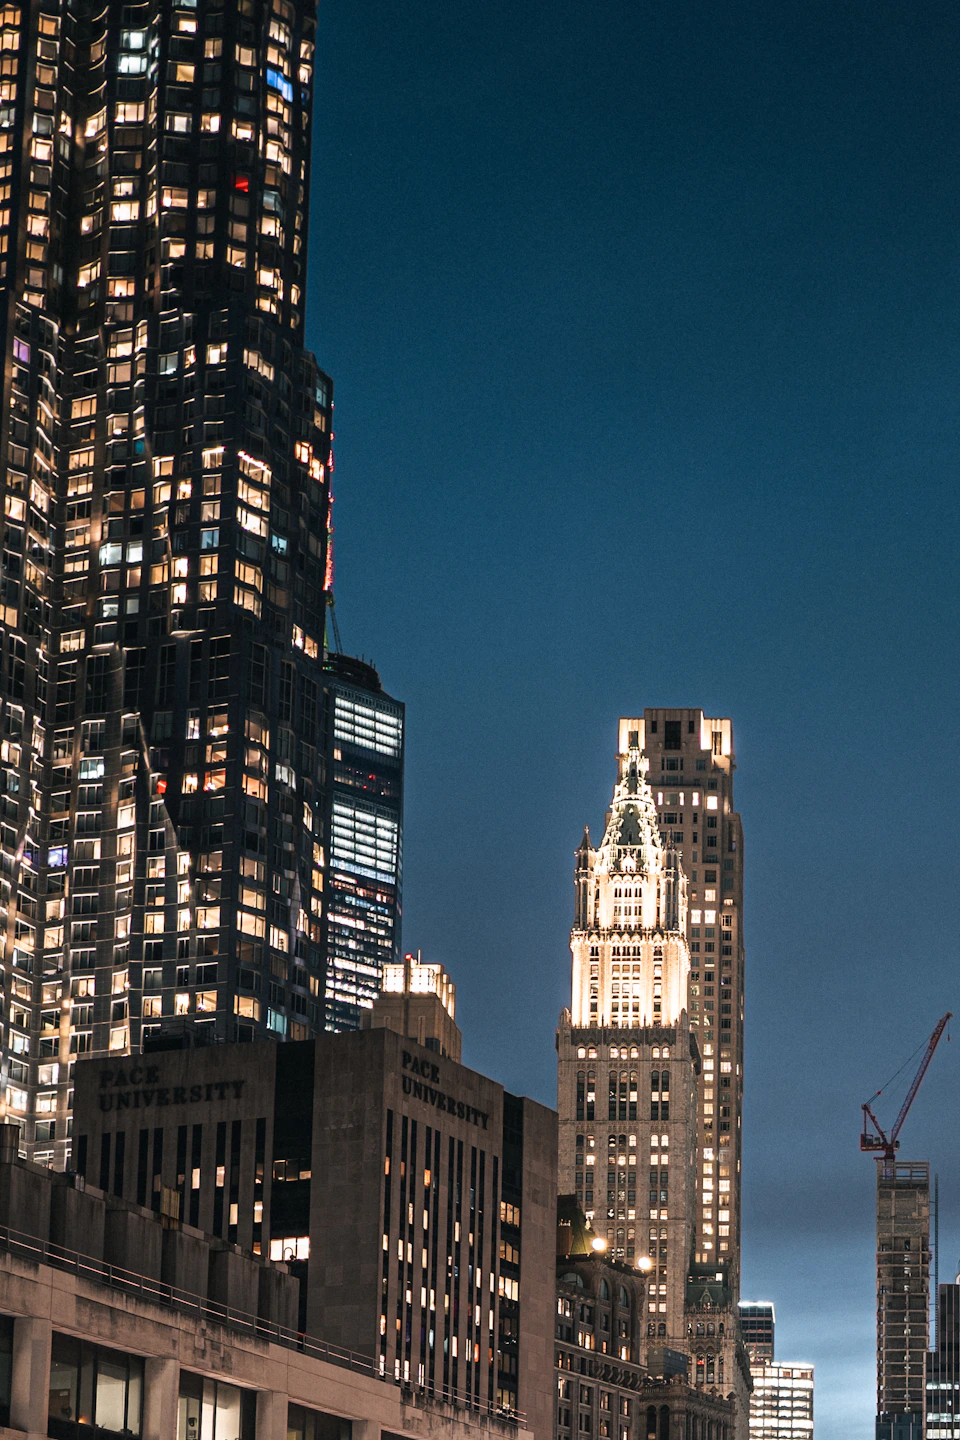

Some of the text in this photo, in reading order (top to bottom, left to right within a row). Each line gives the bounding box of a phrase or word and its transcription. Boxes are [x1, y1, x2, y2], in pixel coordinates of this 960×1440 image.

[100, 1064, 159, 1088] PACE
[402, 1050, 440, 1084] PACE
[100, 1080, 247, 1112] UNIVERSITY
[402, 1074, 489, 1130] UNIVERSITY
